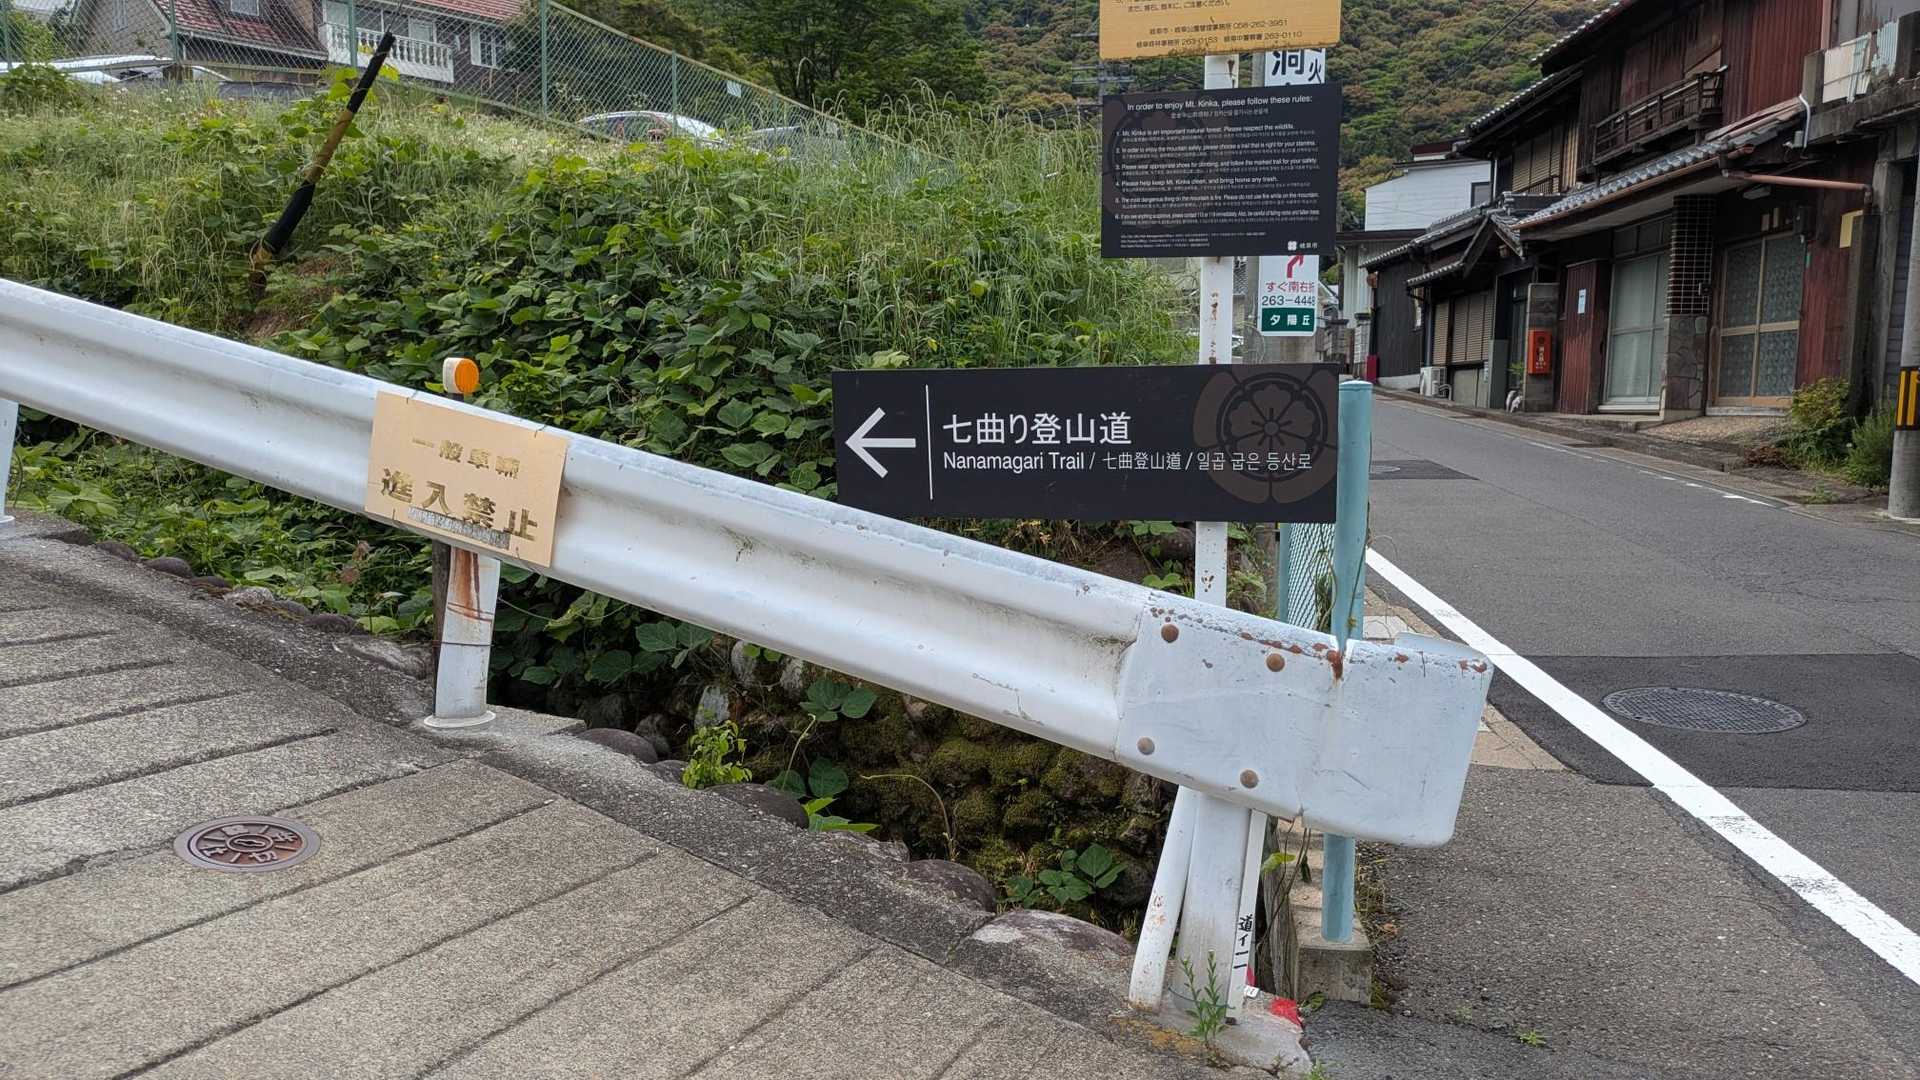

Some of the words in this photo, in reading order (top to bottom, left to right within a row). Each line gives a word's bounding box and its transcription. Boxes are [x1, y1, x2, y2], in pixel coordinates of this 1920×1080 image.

[1164, 103, 1184, 111] enjoy
[1198, 100, 1219, 109] Kinka,
[1221, 99, 1245, 108] please
[1270, 314, 1311, 326] 夕陽丘
[943, 413, 1132, 446] 七曲り登山道
[943, 452, 1045, 474] Nanamagari
[1050, 452, 1084, 471] Trail
[1101, 452, 1182, 471] 七曲登山道
[1266, 452, 1313, 471] 등산로
[380, 467, 538, 541] 進入禁止
